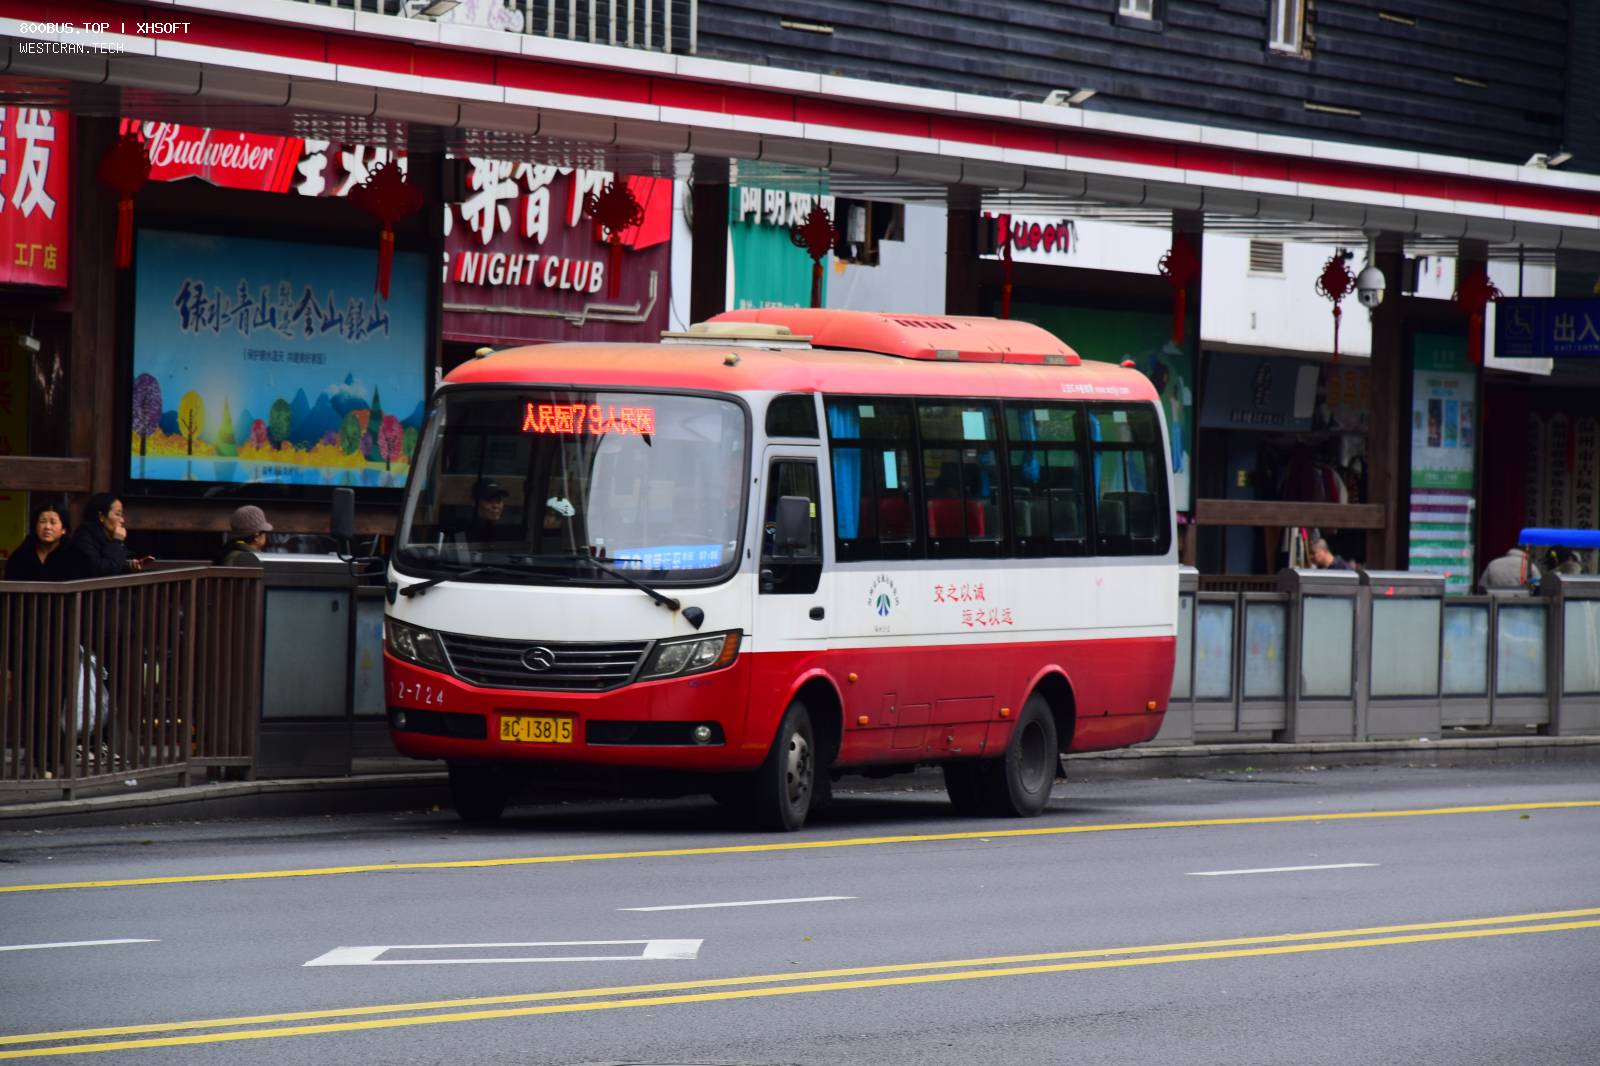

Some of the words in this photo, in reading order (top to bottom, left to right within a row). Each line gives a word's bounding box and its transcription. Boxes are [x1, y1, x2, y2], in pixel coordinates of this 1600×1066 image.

[0, 107, 57, 221] 发
[142, 121, 274, 171] Budweiser
[15, 243, 57, 270] 工厂店
[459, 251, 540, 286] NIGHT
[543, 255, 604, 293] CLUB
[1553, 312, 1600, 342] 出入
